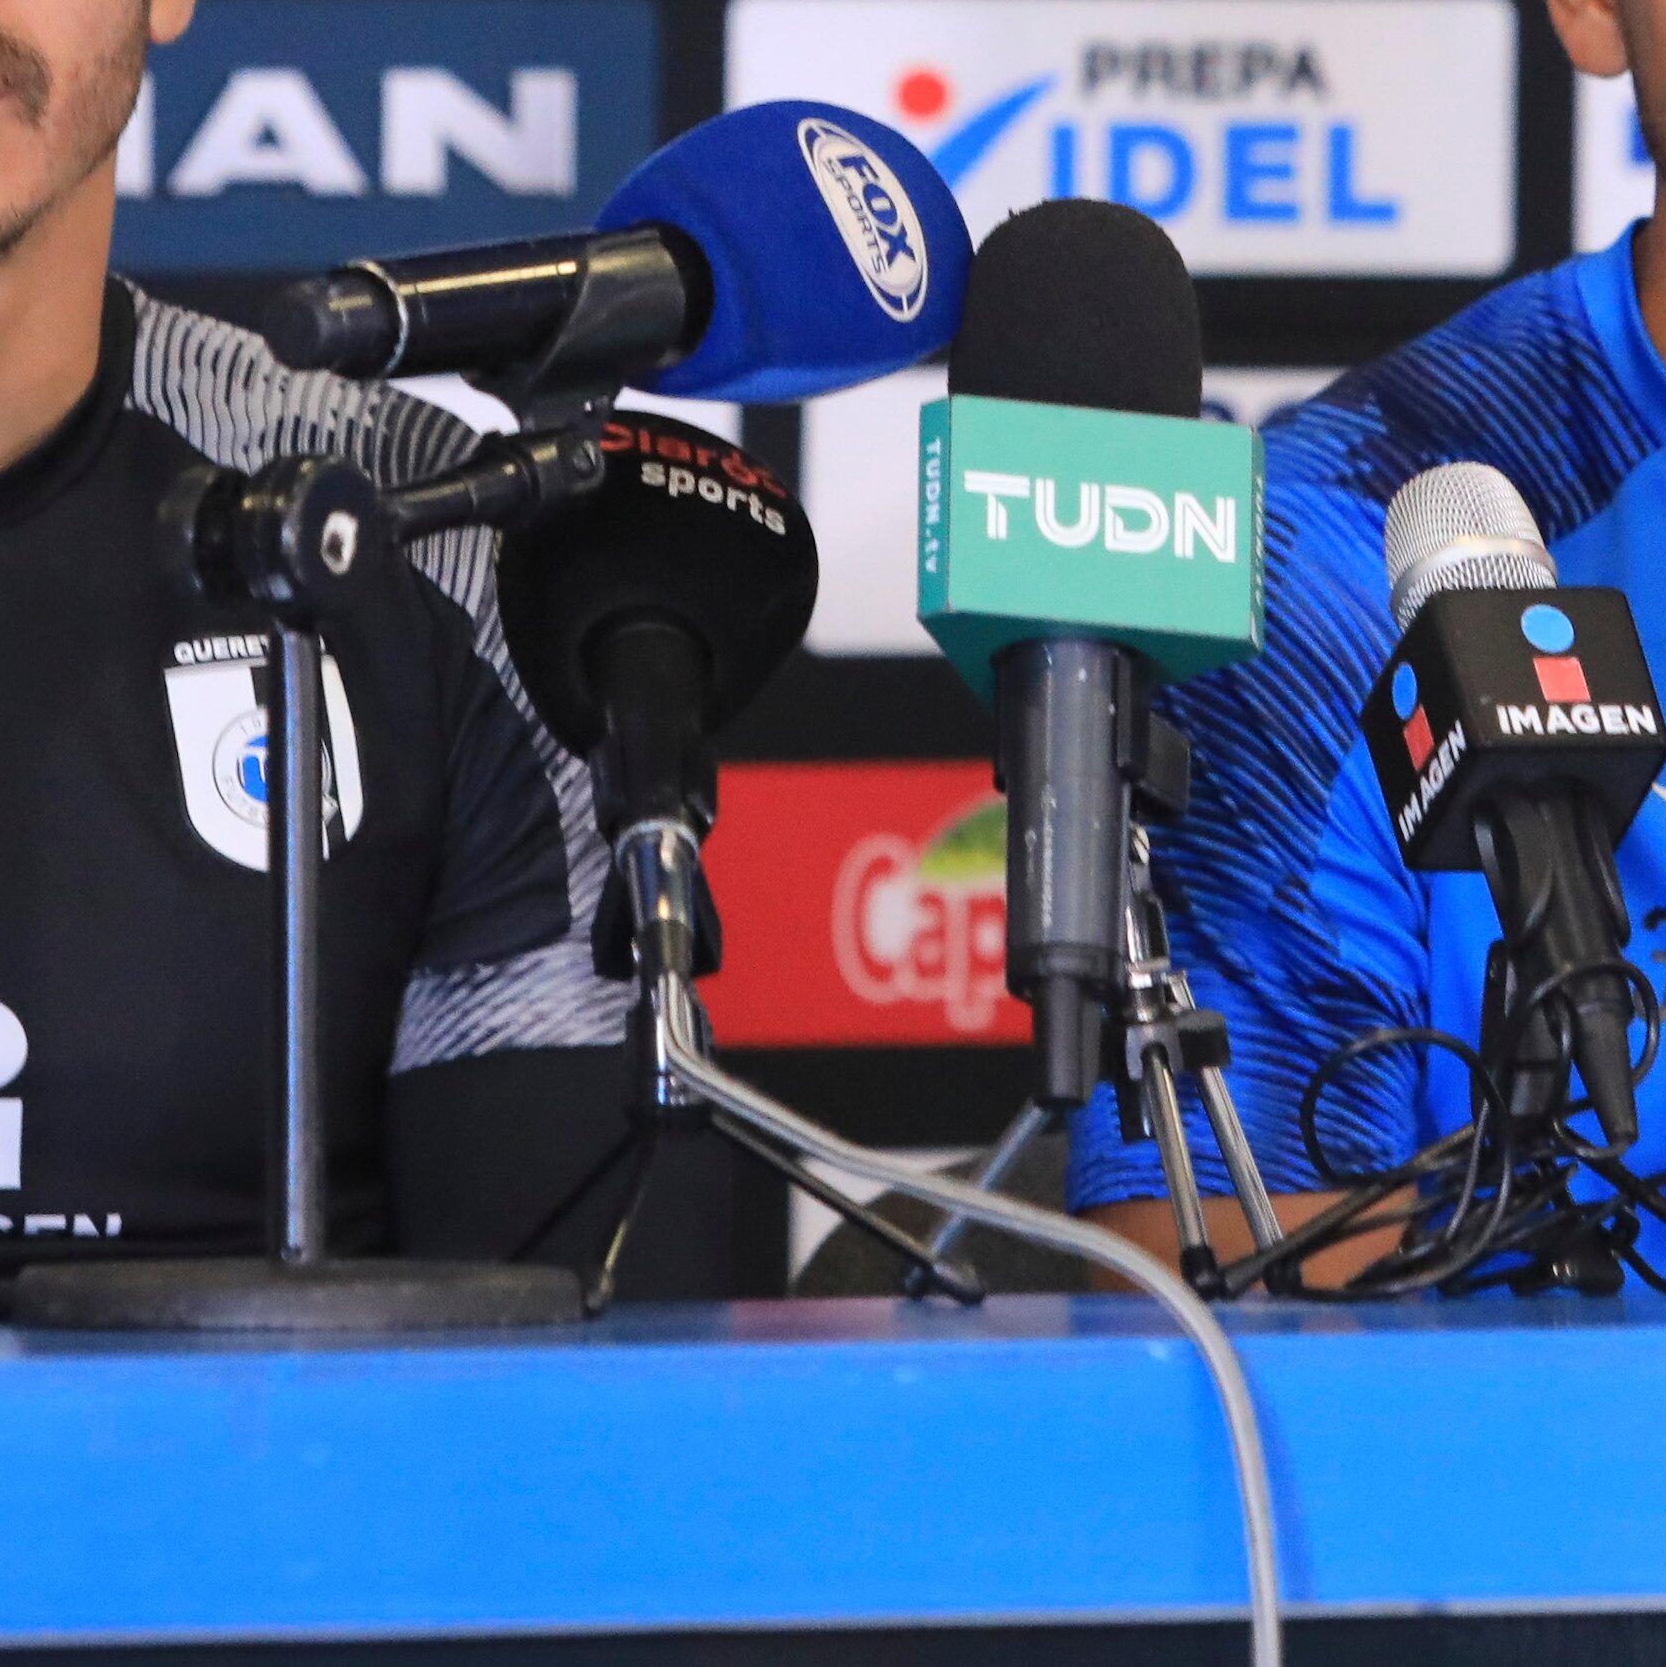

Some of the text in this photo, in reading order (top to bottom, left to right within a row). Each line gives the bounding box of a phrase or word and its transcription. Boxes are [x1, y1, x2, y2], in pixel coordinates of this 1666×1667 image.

[1081, 40, 1330, 102] PREPA
[115, 67, 580, 198] AN
[1050, 122, 1400, 223] IDEL
[824, 157, 887, 274] SPORTS
[837, 154, 917, 269] FOX
[641, 461, 787, 536] sports
[963, 469, 1237, 564] TUDN
[1495, 703, 1658, 735] IMAGEN
[1398, 718, 1468, 843] IMAGEN
